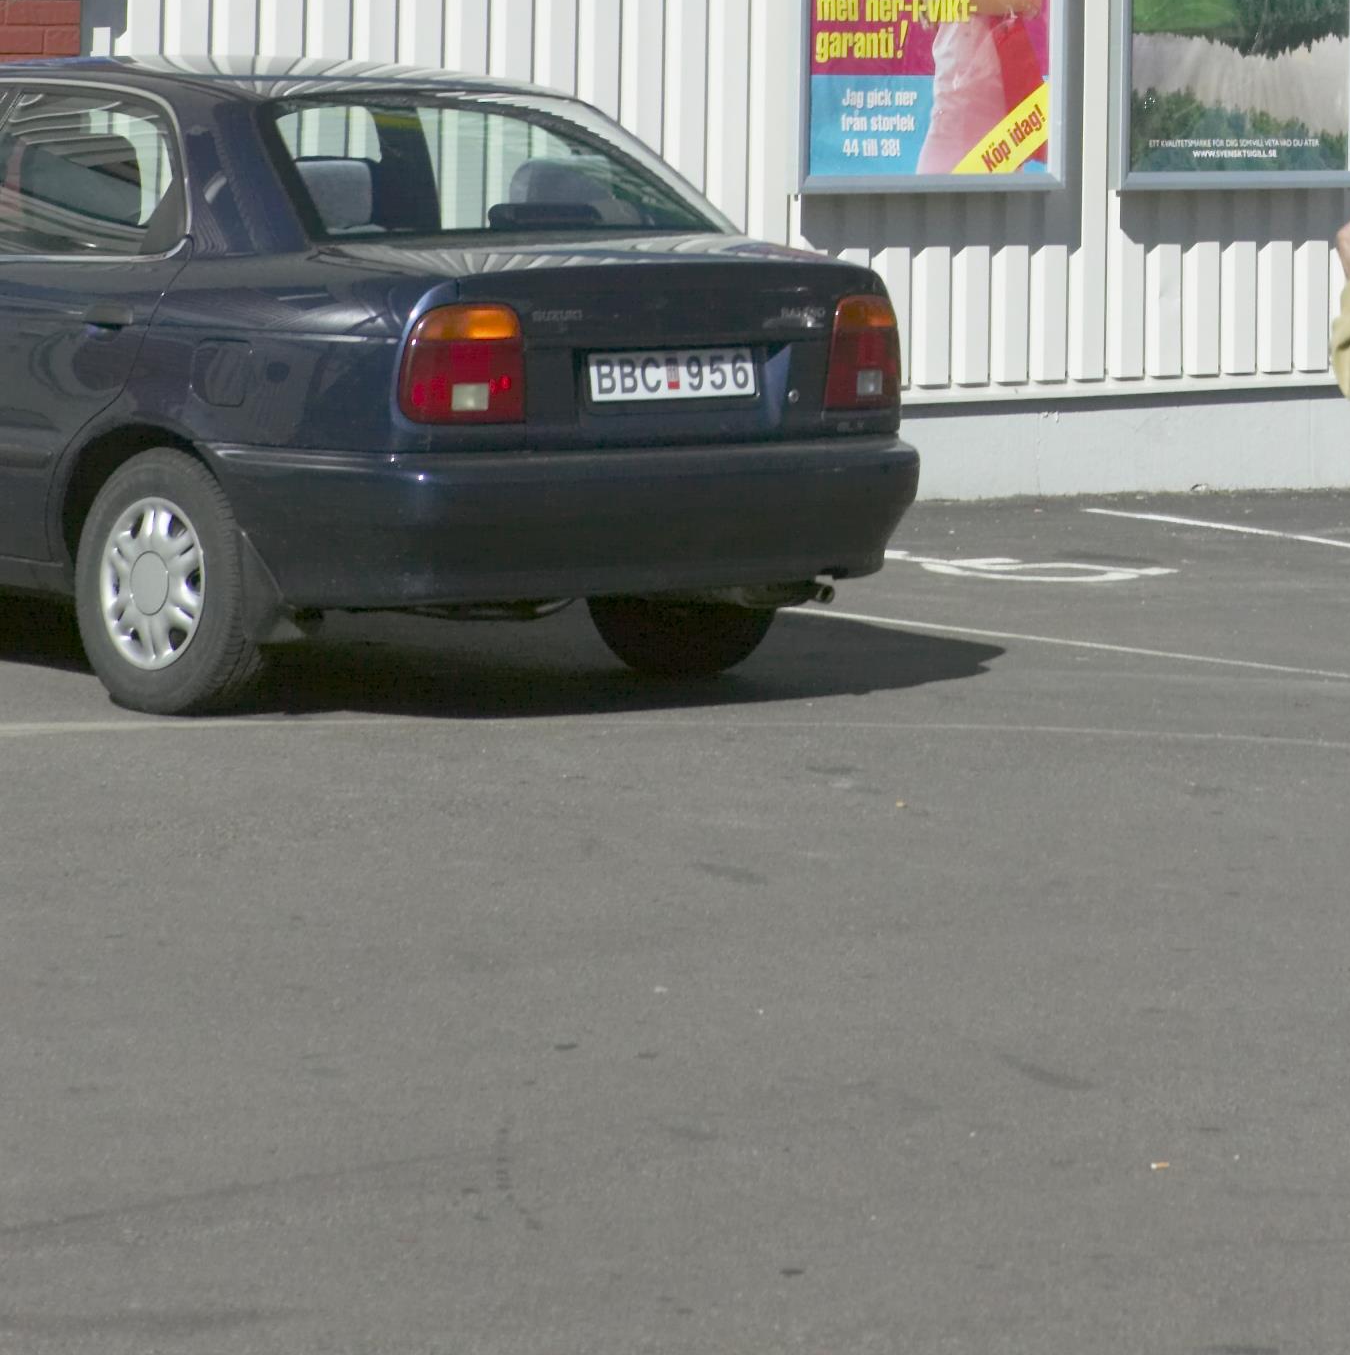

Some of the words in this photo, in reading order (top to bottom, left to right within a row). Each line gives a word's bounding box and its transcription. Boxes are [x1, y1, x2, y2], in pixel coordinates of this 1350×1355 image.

[815, 20, 909, 64] garanti!
[842, 88, 865, 109] Jag
[867, 87, 892, 109] gick
[894, 90, 918, 107] ner
[841, 109, 868, 132] från
[870, 112, 916, 132] storlek
[842, 138, 860, 157] 44
[862, 138, 878, 157] till
[981, 140, 1012, 173] Köp
[1007, 103, 1046, 148] idag!
[596, 359, 662, 394] BBC
[687, 355, 752, 391] 956
